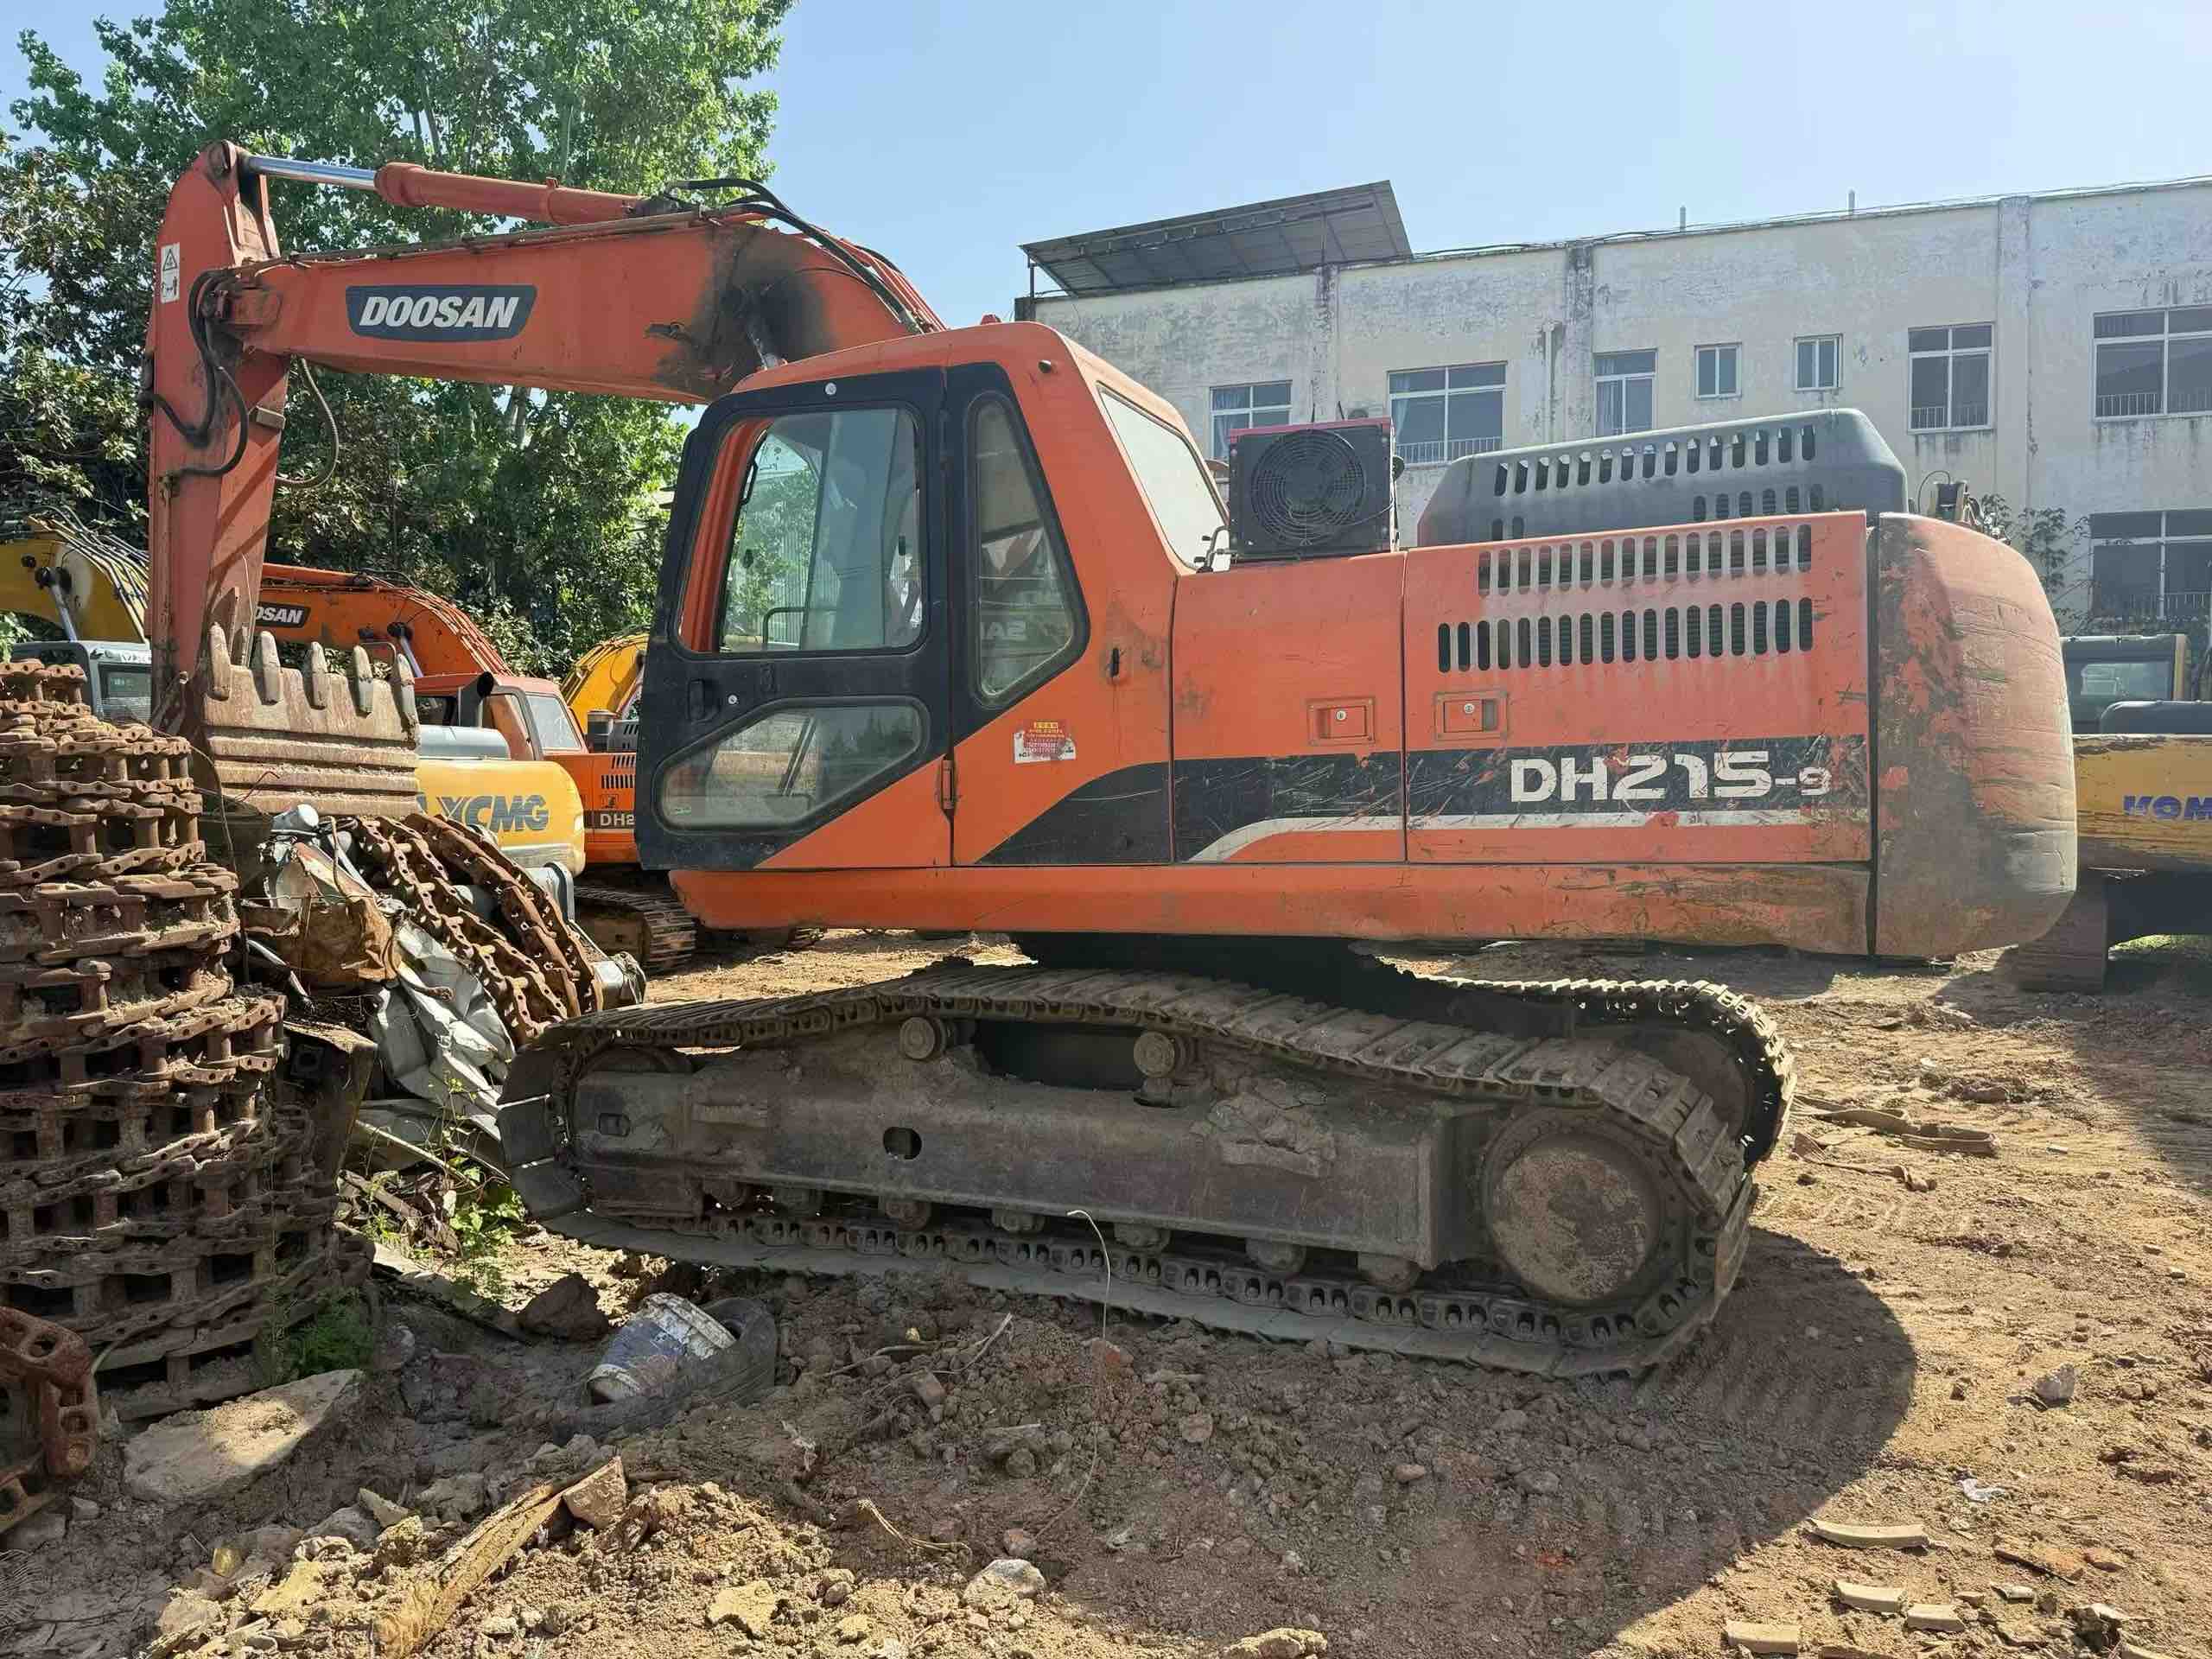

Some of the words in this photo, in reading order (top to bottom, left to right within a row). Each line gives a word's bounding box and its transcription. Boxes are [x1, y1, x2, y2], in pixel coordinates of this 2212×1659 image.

[359, 296, 519, 328] DOOSAN
[1511, 750, 1833, 803] DH215-9
[436, 794, 549, 831] XCMG
